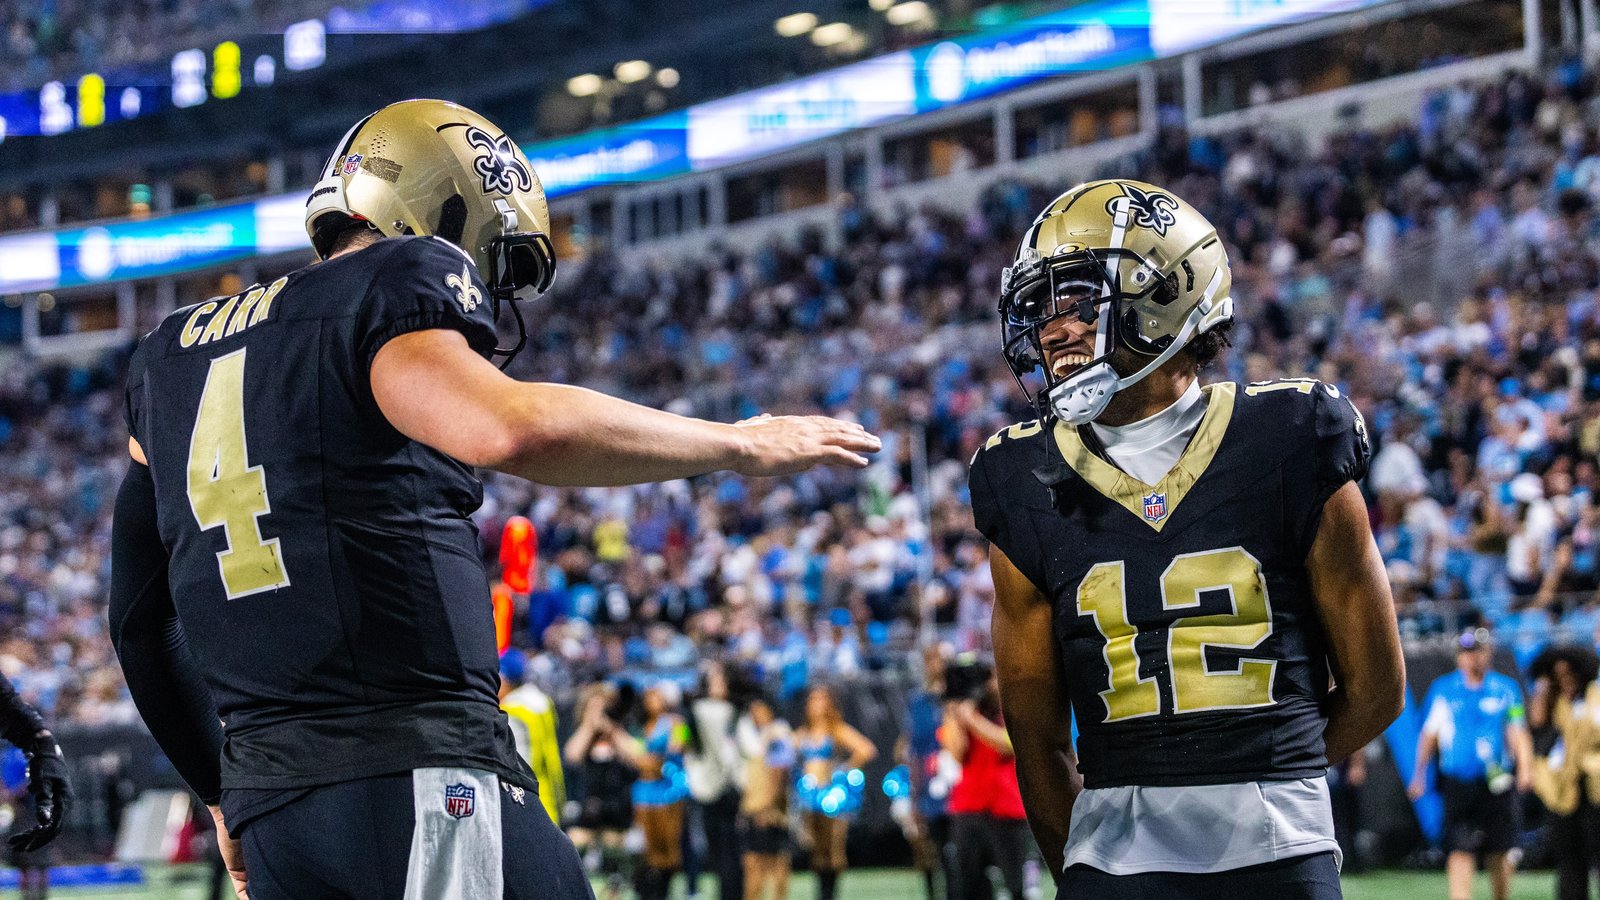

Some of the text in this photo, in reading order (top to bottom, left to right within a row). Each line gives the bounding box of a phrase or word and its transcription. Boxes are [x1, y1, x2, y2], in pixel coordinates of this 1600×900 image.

[180, 276, 288, 349] CARR
[187, 346, 291, 601] 4
[1076, 545, 1278, 724] 12
[447, 797, 472, 816] NFL
